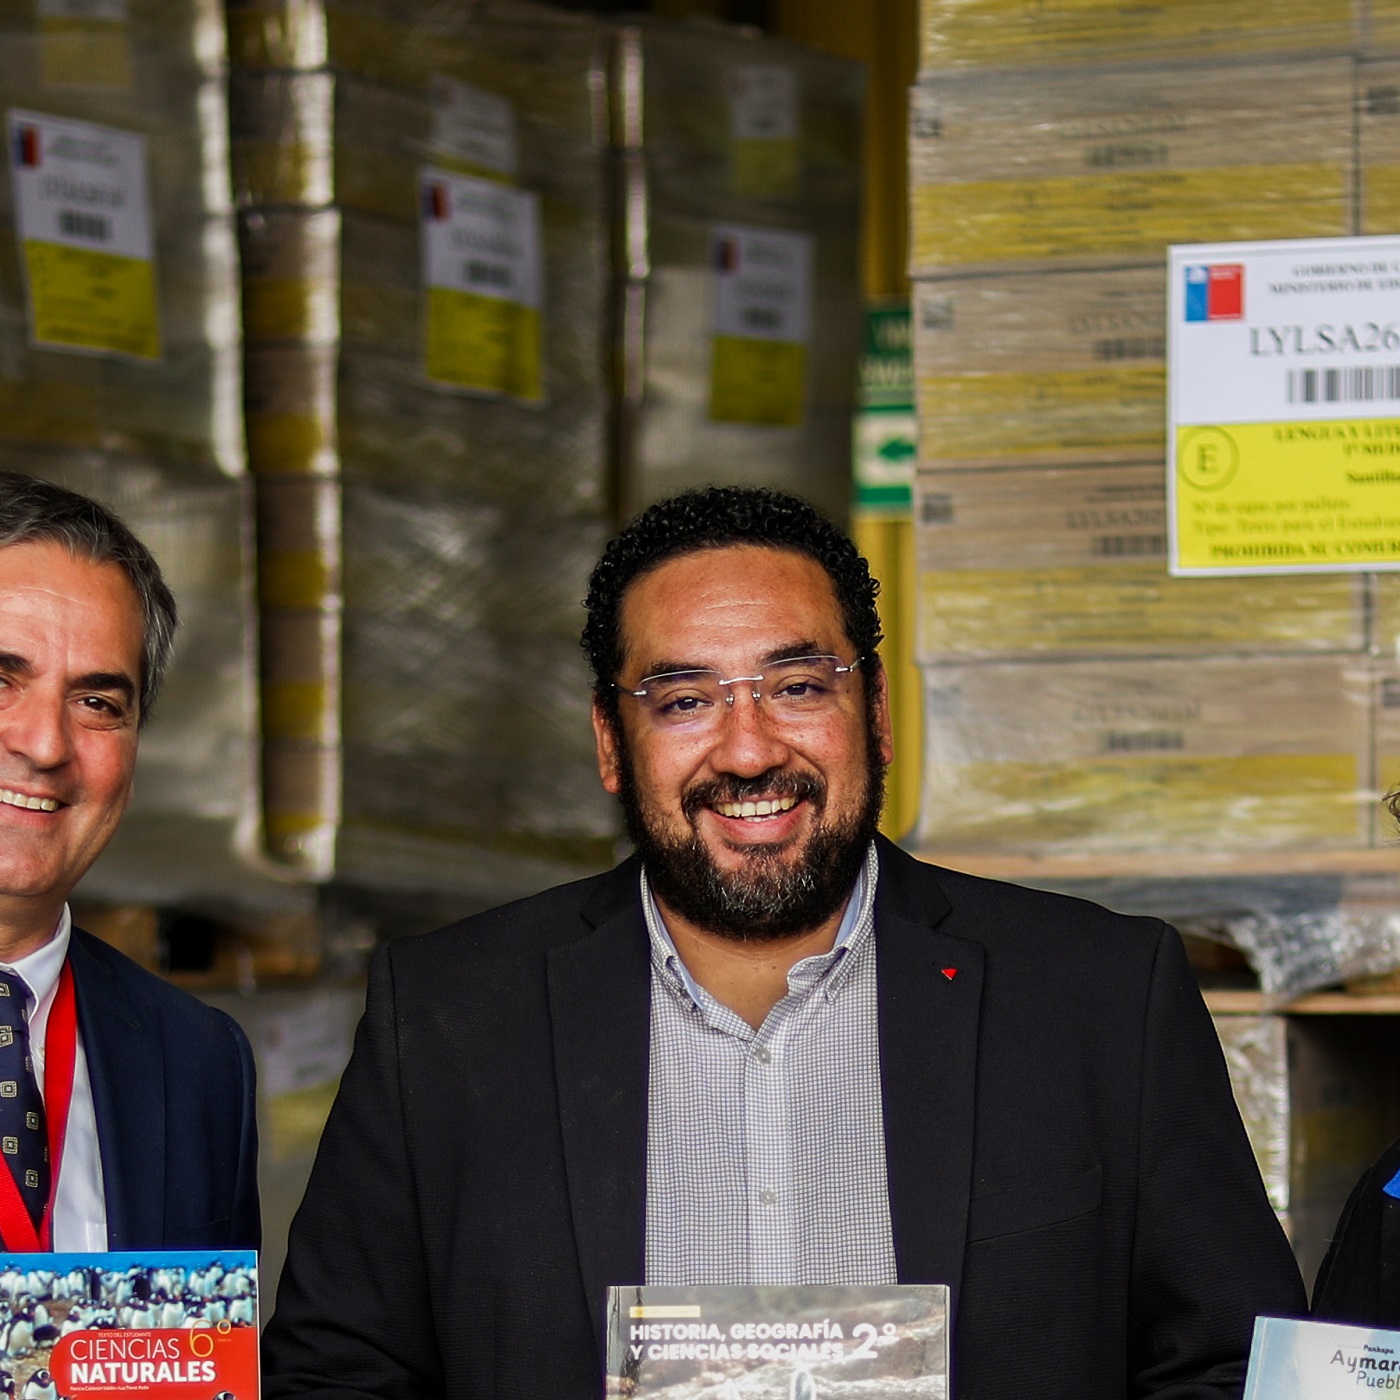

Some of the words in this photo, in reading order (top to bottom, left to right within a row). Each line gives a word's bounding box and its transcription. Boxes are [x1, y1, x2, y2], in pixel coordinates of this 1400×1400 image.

[1273, 424, 1344, 442] LENGUA
[1197, 442, 1219, 474] E
[630, 1323, 726, 1342] HISTORIA,
[730, 1318, 844, 1340] GEOGRAFÍA
[70, 1337, 180, 1361] CIENCIAS
[630, 1344, 643, 1361] Y
[648, 1343, 743, 1360] CIENCIAS
[747, 1343, 845, 1361] SOCIALES
[70, 1360, 217, 1384] NATURALES
